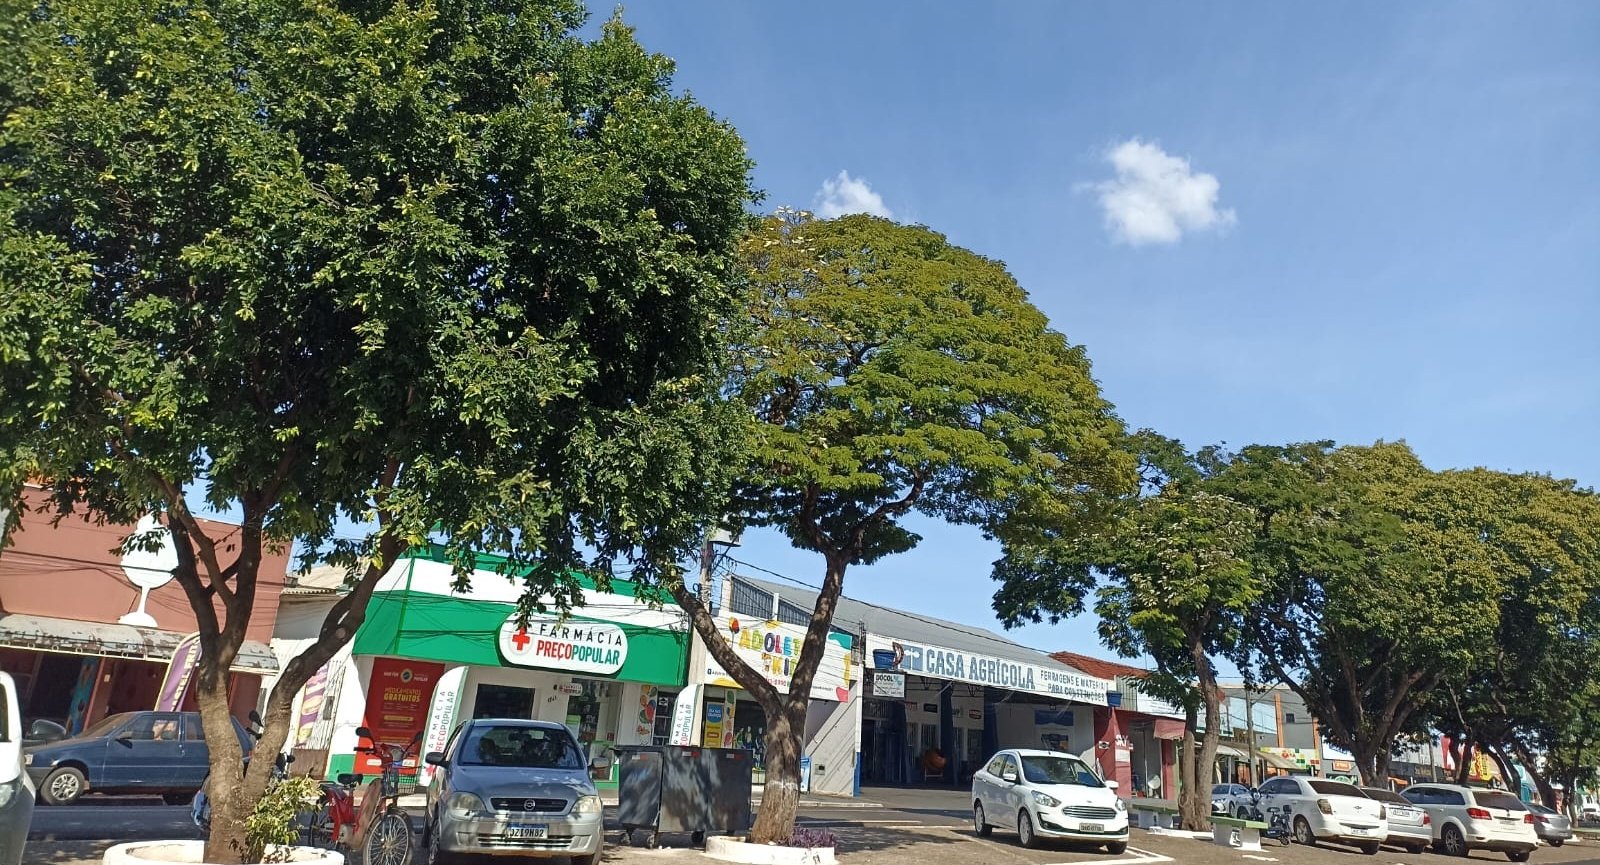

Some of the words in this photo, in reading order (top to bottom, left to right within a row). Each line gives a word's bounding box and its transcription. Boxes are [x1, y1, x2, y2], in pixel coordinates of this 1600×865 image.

[539, 623, 622, 646] FARMÁCIA
[536, 640, 621, 665] PREÇOPOPULAR
[926, 648, 965, 679] CASA
[968, 656, 1036, 690] AGRÍCOLA
[1040, 669, 1075, 685] FERRAGENS
[1075, 676, 1080, 687] E
[383, 693, 421, 703] GRATUITOS
[1047, 683, 1064, 695] PARA
